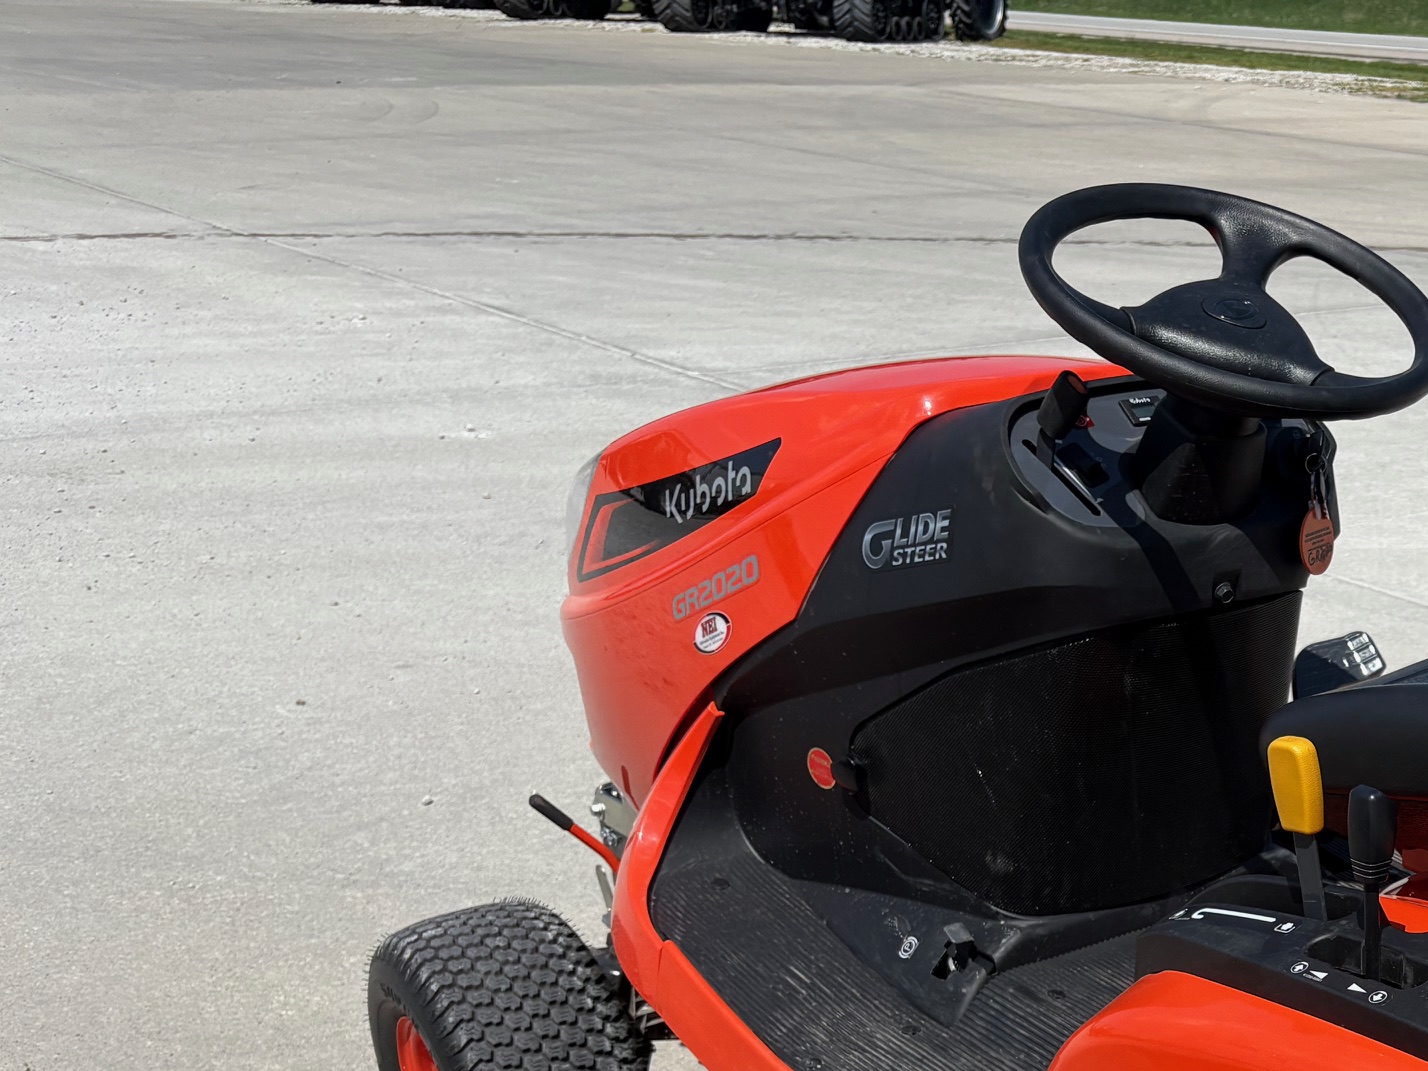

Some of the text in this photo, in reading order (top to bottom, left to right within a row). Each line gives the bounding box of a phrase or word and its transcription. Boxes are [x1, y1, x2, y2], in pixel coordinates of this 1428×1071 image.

[665, 460, 752, 524] Kubota
[862, 508, 952, 569] GLIDE
[892, 542, 948, 566] STEER
[672, 554, 759, 621] GR2020
[701, 616, 718, 639] NEI
